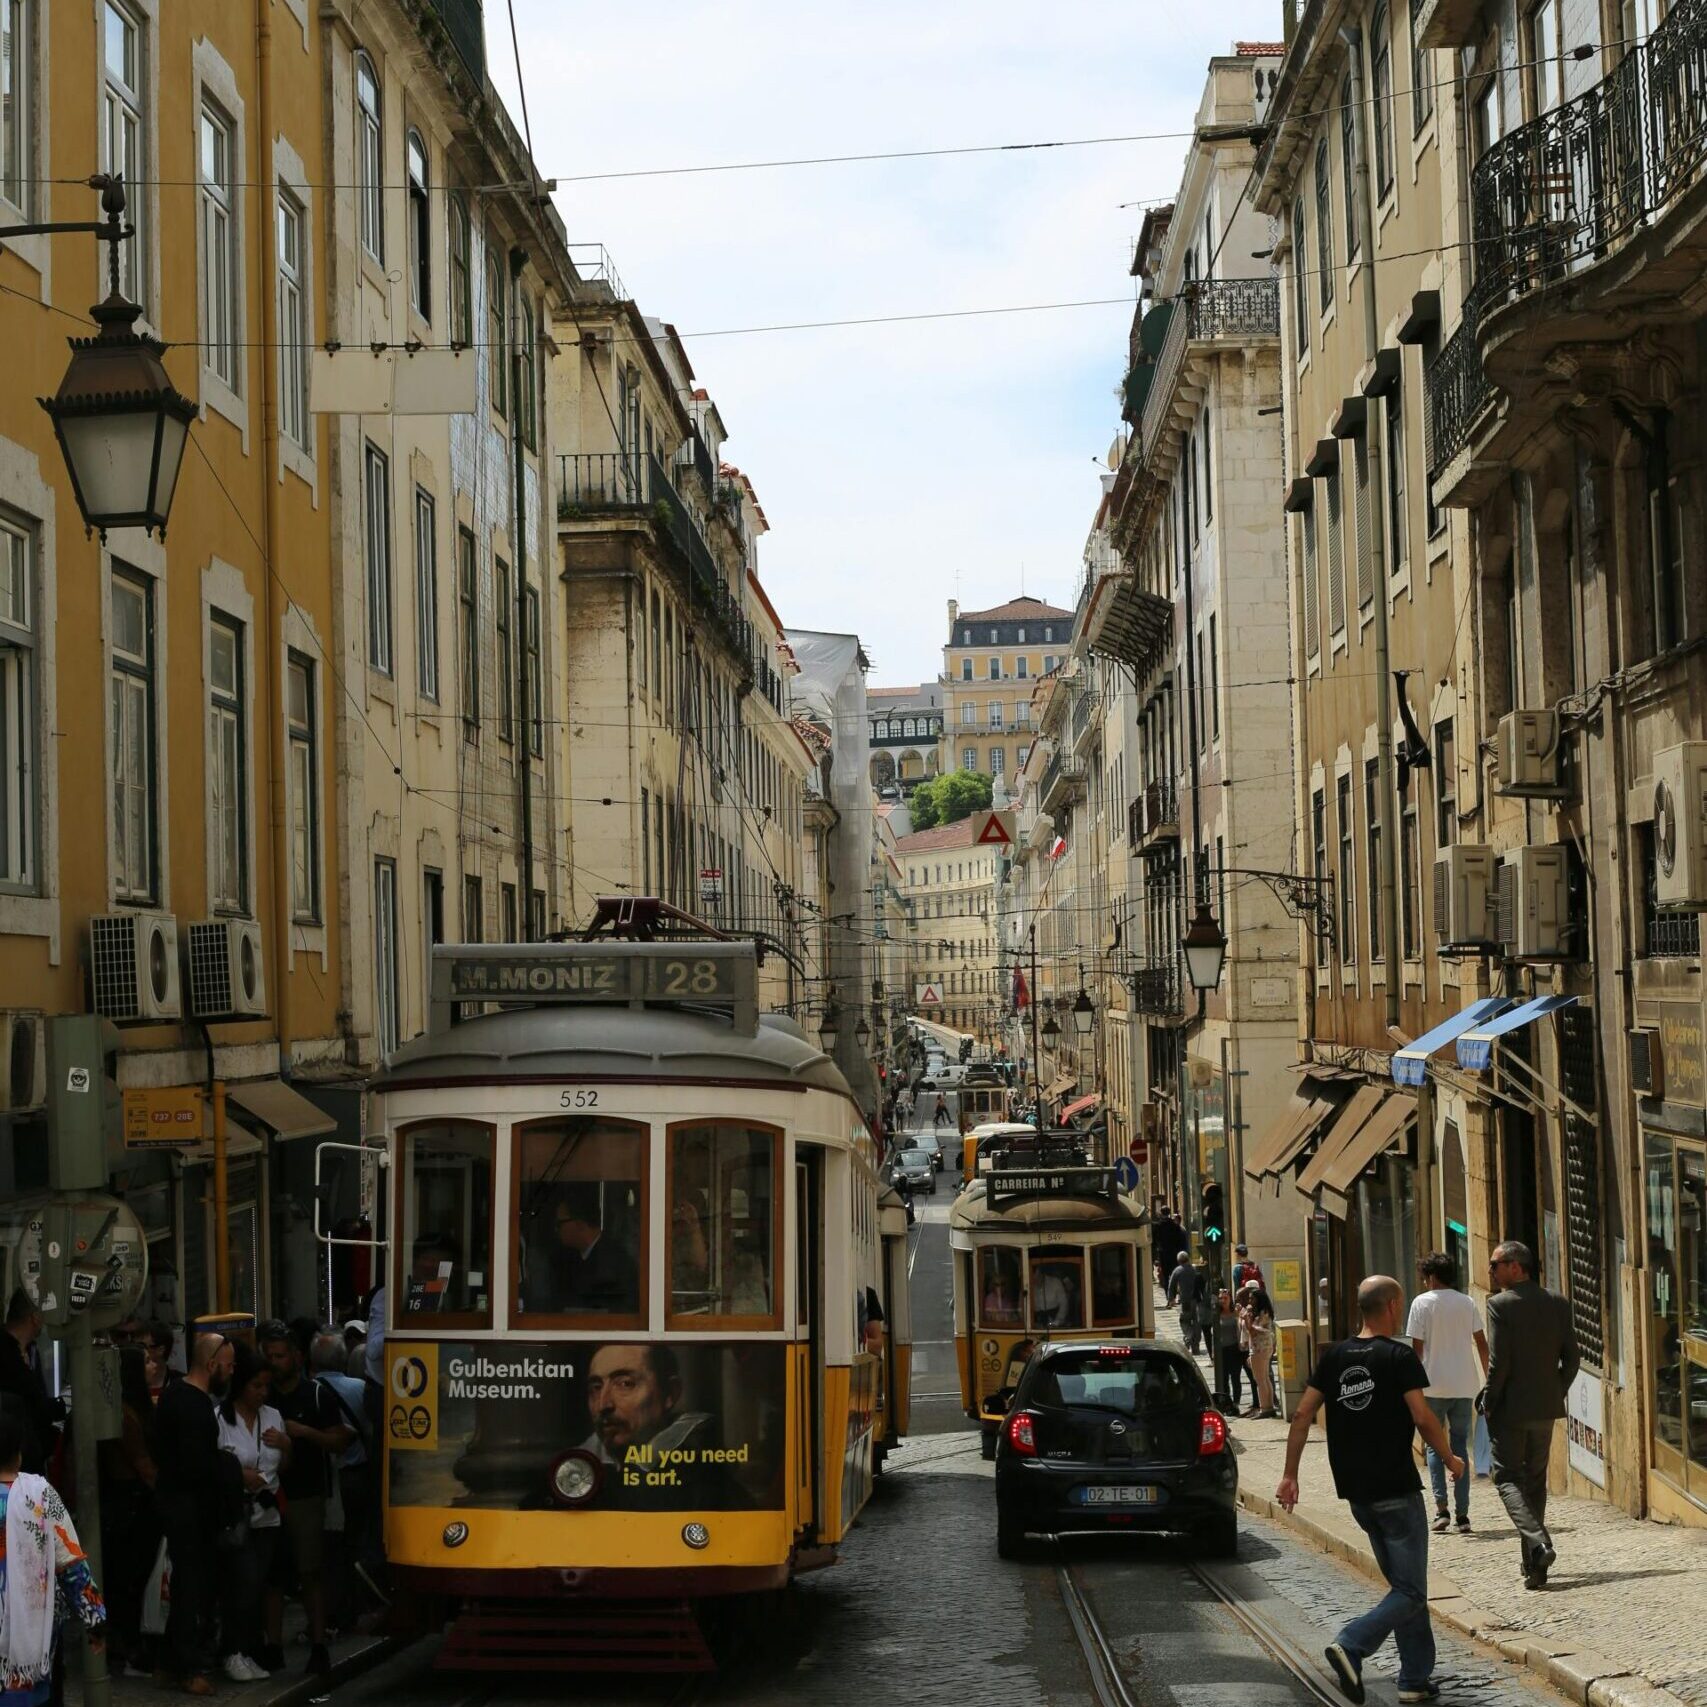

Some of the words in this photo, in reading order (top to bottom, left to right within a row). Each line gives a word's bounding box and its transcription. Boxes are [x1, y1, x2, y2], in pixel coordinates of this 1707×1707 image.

[461, 964, 617, 991] M.MONIZ
[664, 959, 718, 995] 28
[560, 1090, 598, 1108] 552
[994, 1178, 1046, 1191] CARREIRA
[408, 1299, 421, 1311] 16
[448, 1358, 574, 1379] Gulbenkian
[448, 1379, 542, 1400] Museum.
[623, 1443, 653, 1464] All
[658, 1448, 699, 1468] you
[701, 1443, 749, 1464] need
[623, 1466, 640, 1486] is
[644, 1468, 682, 1487] art.
